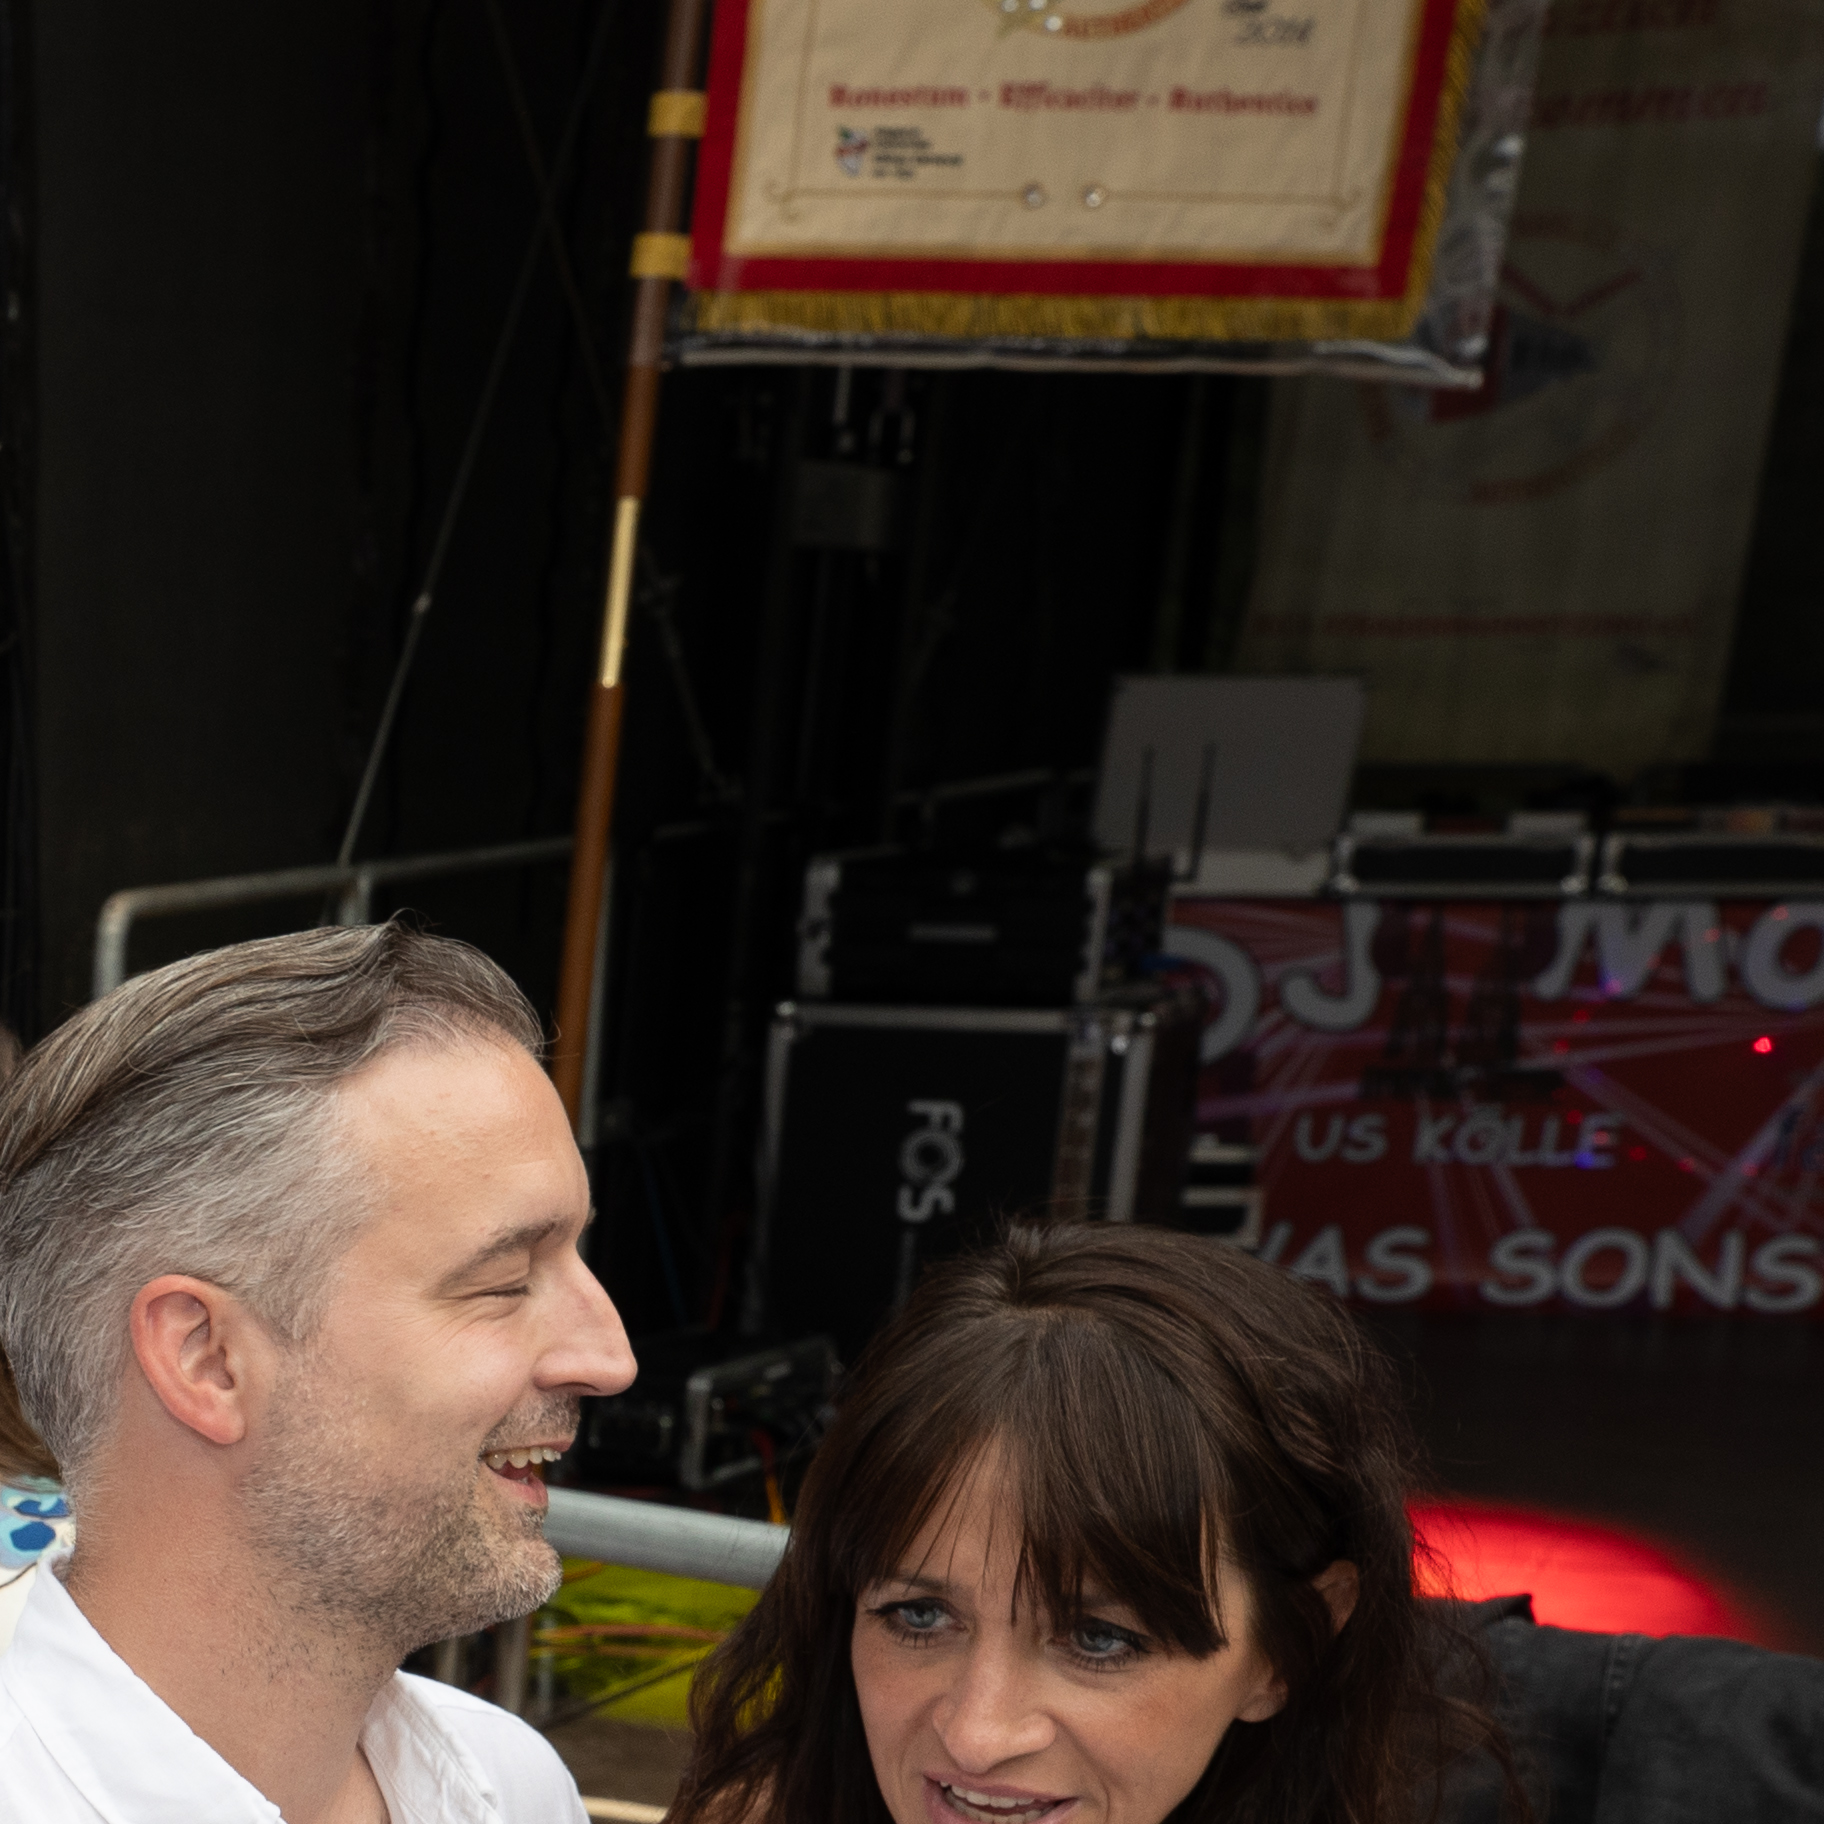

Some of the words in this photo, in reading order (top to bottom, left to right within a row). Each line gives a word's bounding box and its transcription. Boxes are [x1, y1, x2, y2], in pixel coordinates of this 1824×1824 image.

[895, 1099, 965, 1223] FOS
[1293, 1114, 1389, 1164] US
[1412, 1103, 1627, 1169] KÖLLE
